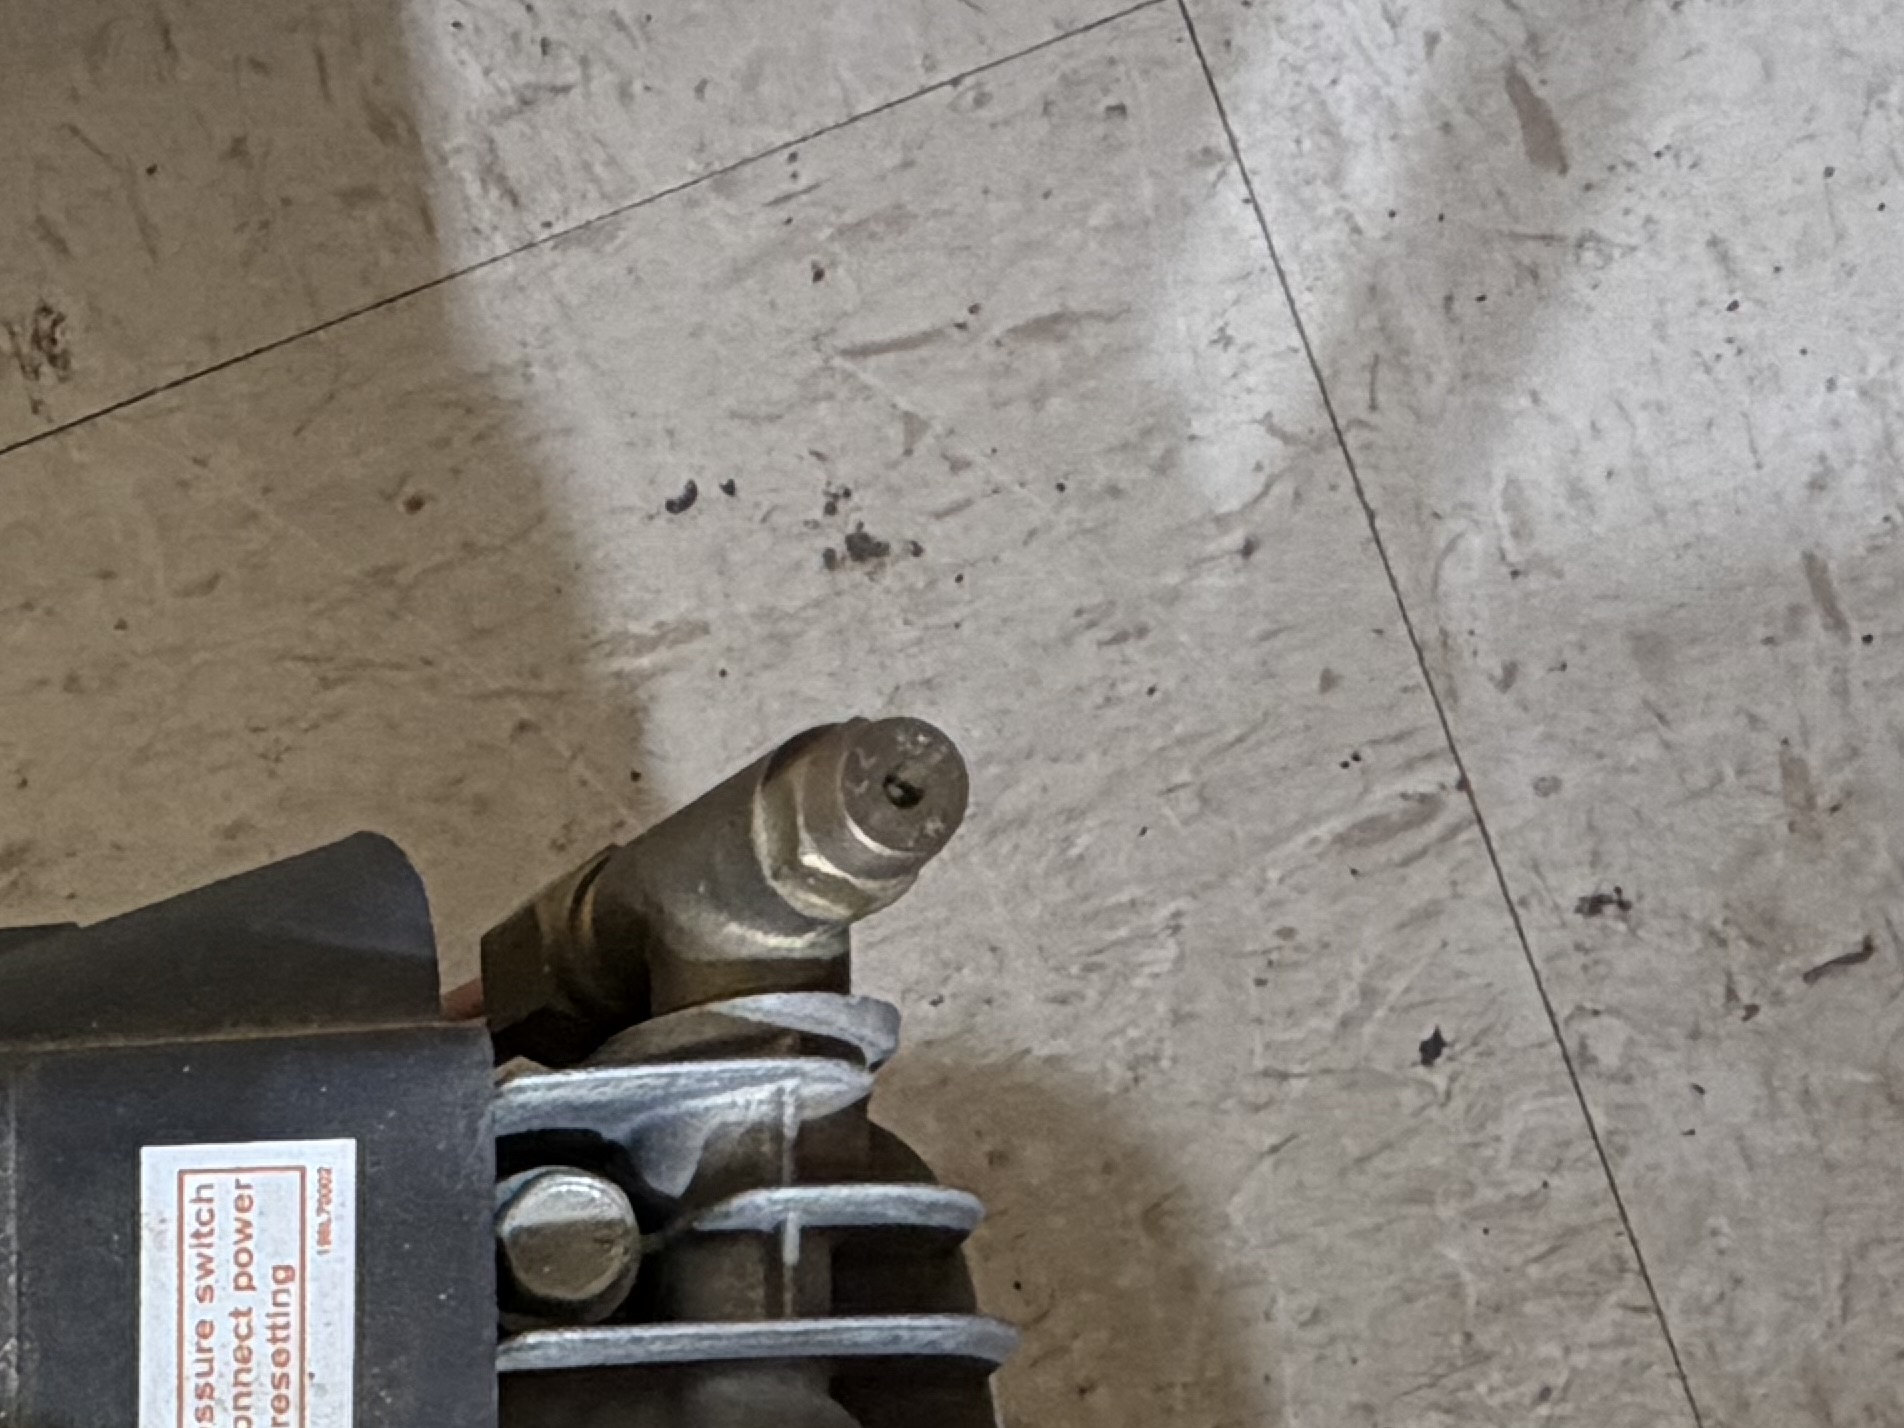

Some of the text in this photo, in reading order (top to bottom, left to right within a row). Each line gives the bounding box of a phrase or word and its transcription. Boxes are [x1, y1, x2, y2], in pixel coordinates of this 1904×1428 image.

[189, 1183, 215, 1303] switch
[233, 1179, 258, 1292] power
[268, 1264, 295, 1428] resetting
